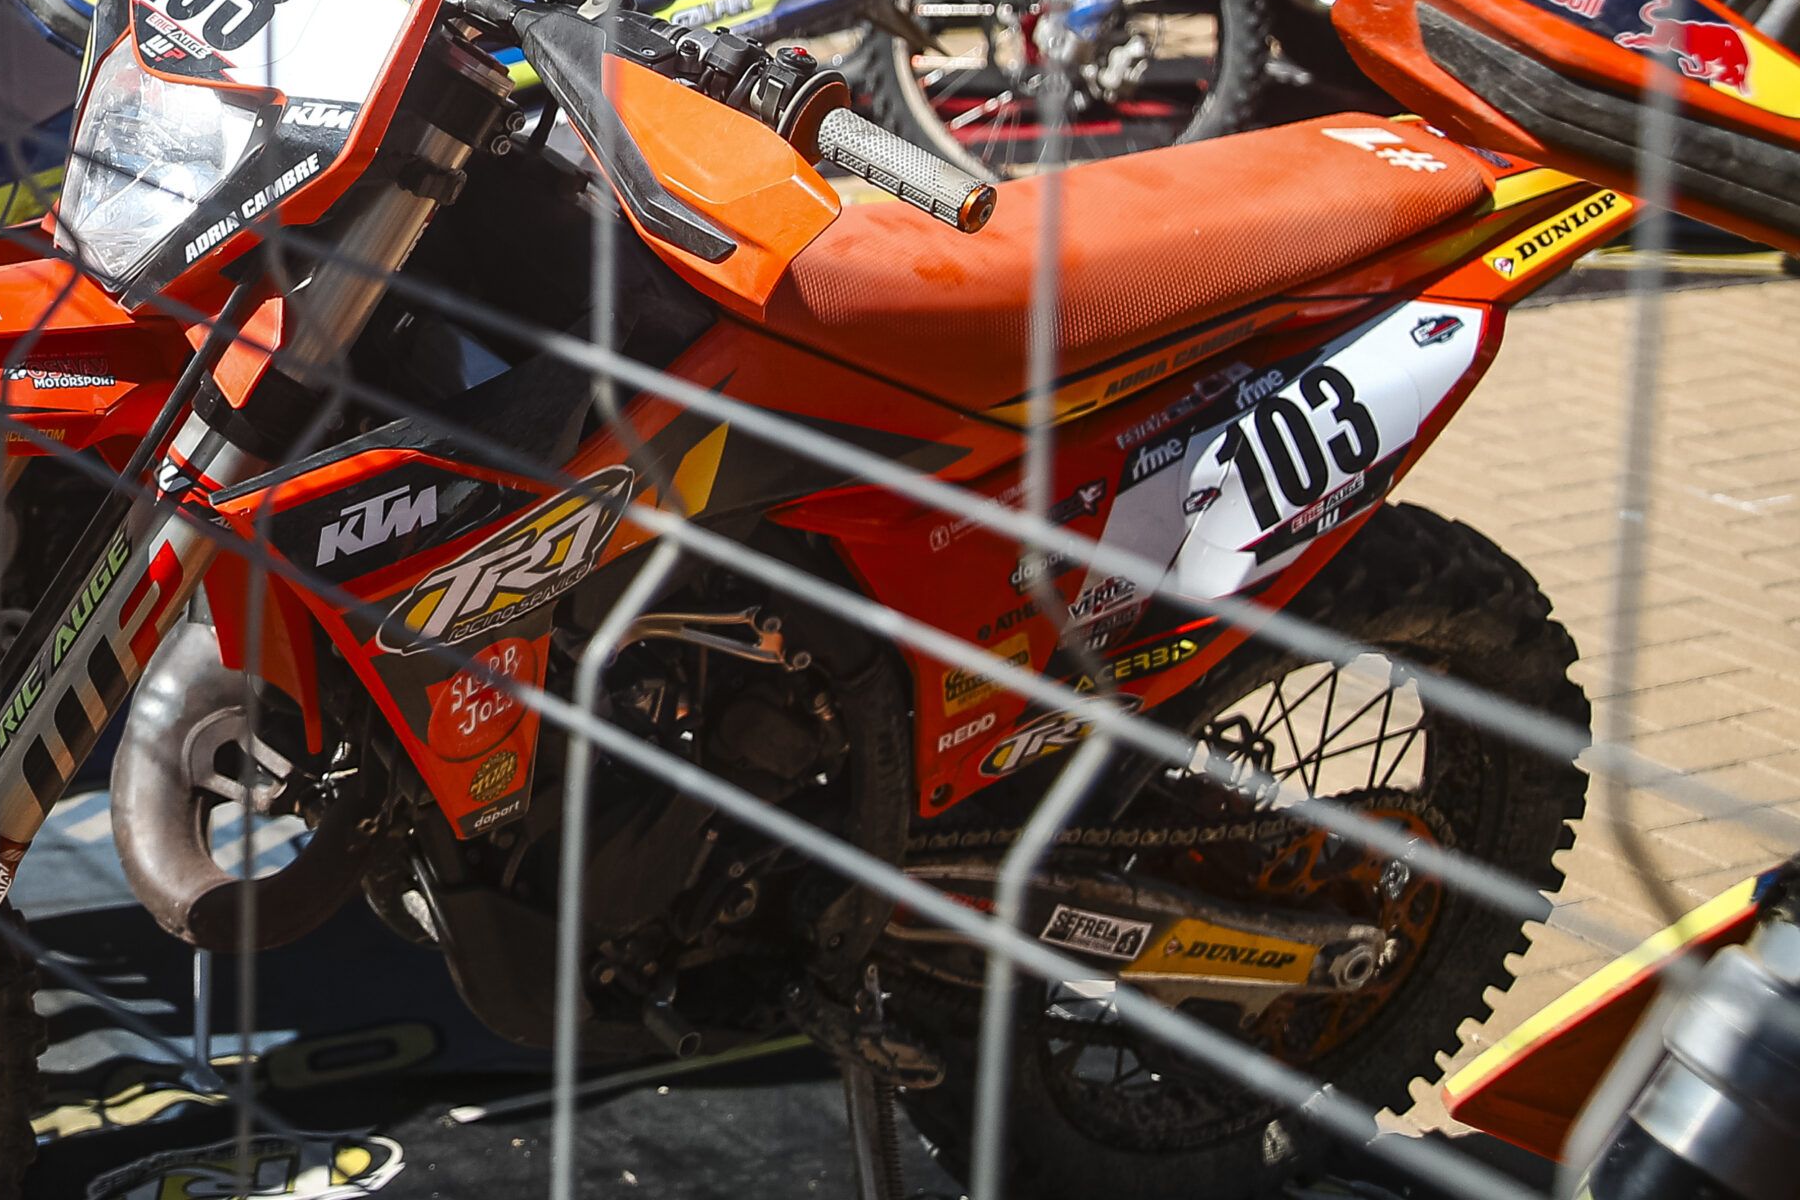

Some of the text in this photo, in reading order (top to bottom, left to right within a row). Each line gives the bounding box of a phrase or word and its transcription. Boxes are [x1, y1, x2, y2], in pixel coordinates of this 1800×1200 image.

[146, 12, 178, 35] ERIC
[282, 102, 355, 129] KTM
[184, 152, 320, 264] ADRIA CAMBRE
[1515, 192, 1617, 261] DUNLOP
[33, 375, 117, 389] MOTORSPORT
[1131, 437, 1183, 481] rfme
[1216, 365, 1380, 532] 103
[315, 484, 438, 566] KTM
[938, 711, 997, 753] REDD
[1187, 940, 1297, 970] DUNLOP
